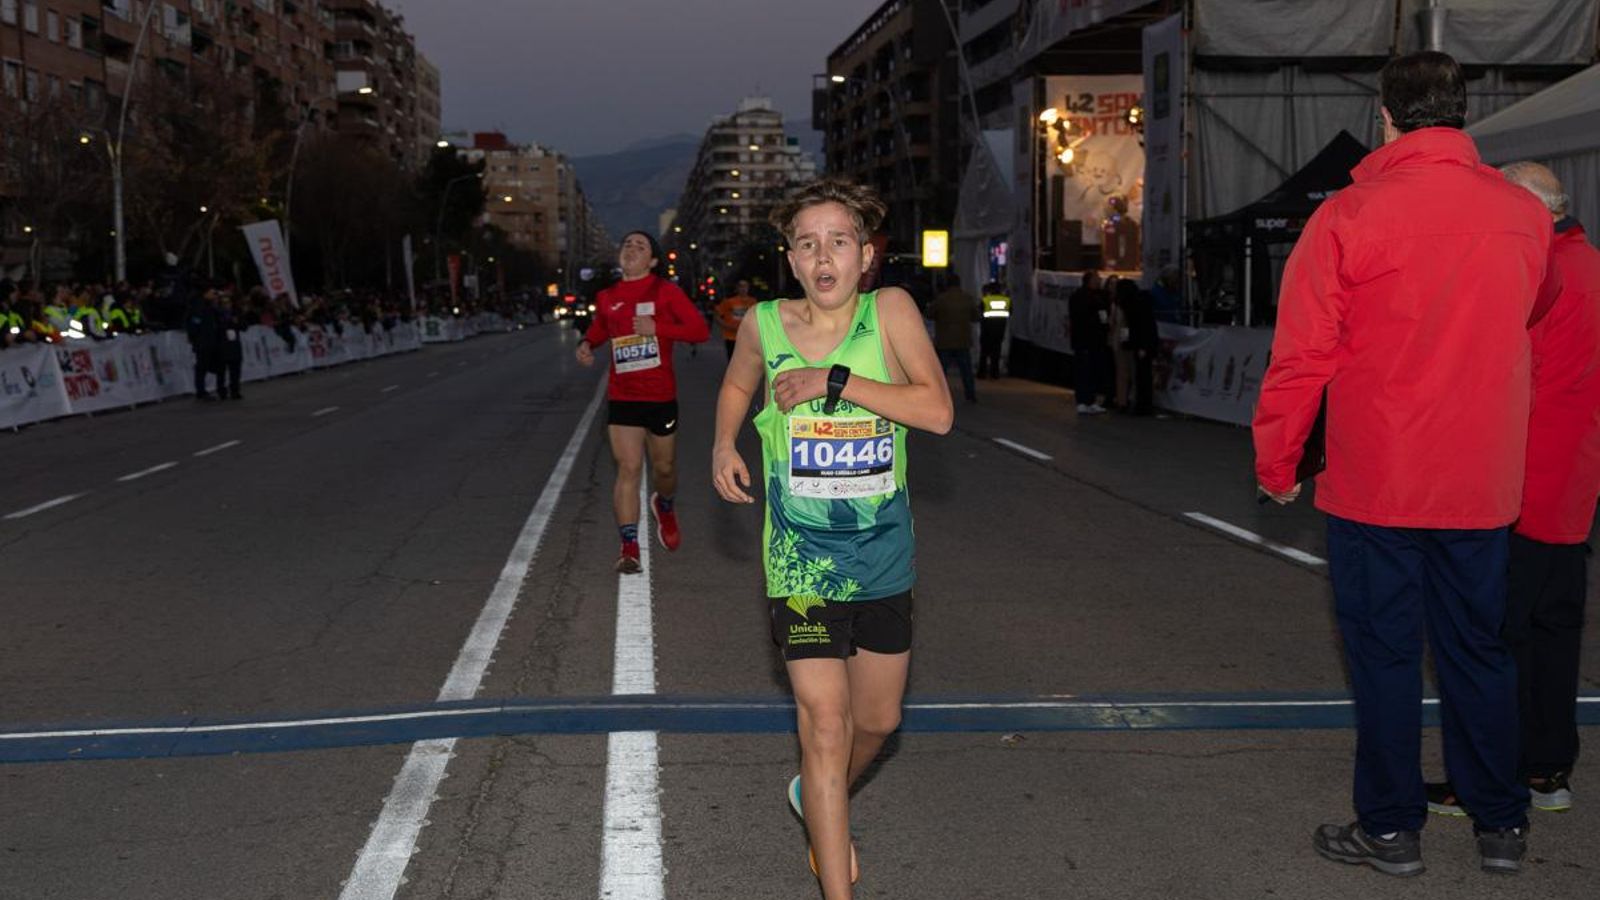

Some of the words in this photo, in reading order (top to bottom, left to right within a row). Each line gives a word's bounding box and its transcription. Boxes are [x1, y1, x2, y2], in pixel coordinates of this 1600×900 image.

[1065, 93, 1094, 113] 42
[616, 343, 656, 359] 10576
[814, 421, 833, 435] 42
[794, 438, 892, 467] 10446
[790, 621, 827, 634] Unicaja
